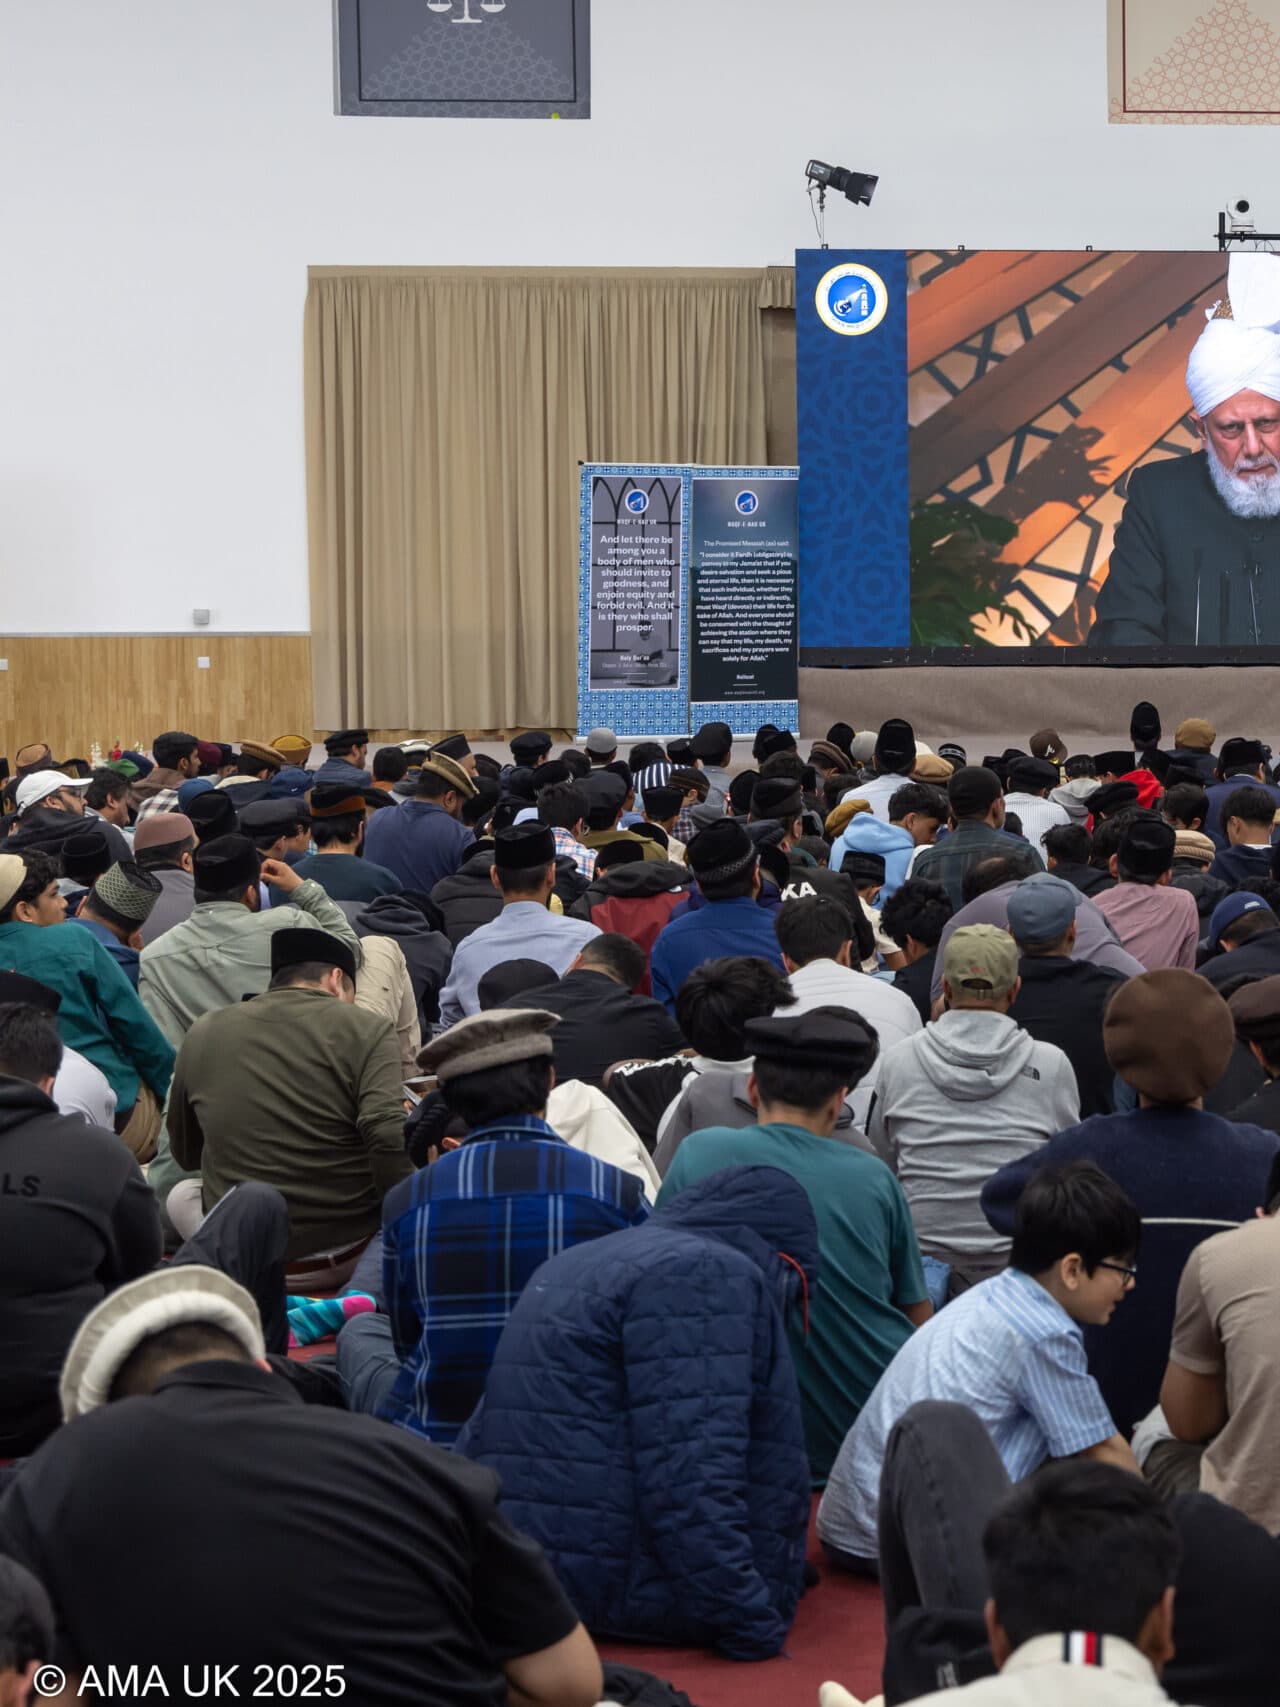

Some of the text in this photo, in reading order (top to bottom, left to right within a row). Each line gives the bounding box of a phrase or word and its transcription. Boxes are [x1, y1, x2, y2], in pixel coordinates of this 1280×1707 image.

[608, 548, 639, 556] among
[598, 558, 620, 567] body
[603, 580, 649, 589] goodness,
[597, 591, 624, 600] enjoin
[627, 591, 655, 599] equity
[597, 601, 674, 609] forbid evil. And it
[608, 613, 628, 622] they
[616, 624, 654, 632] prosper.
